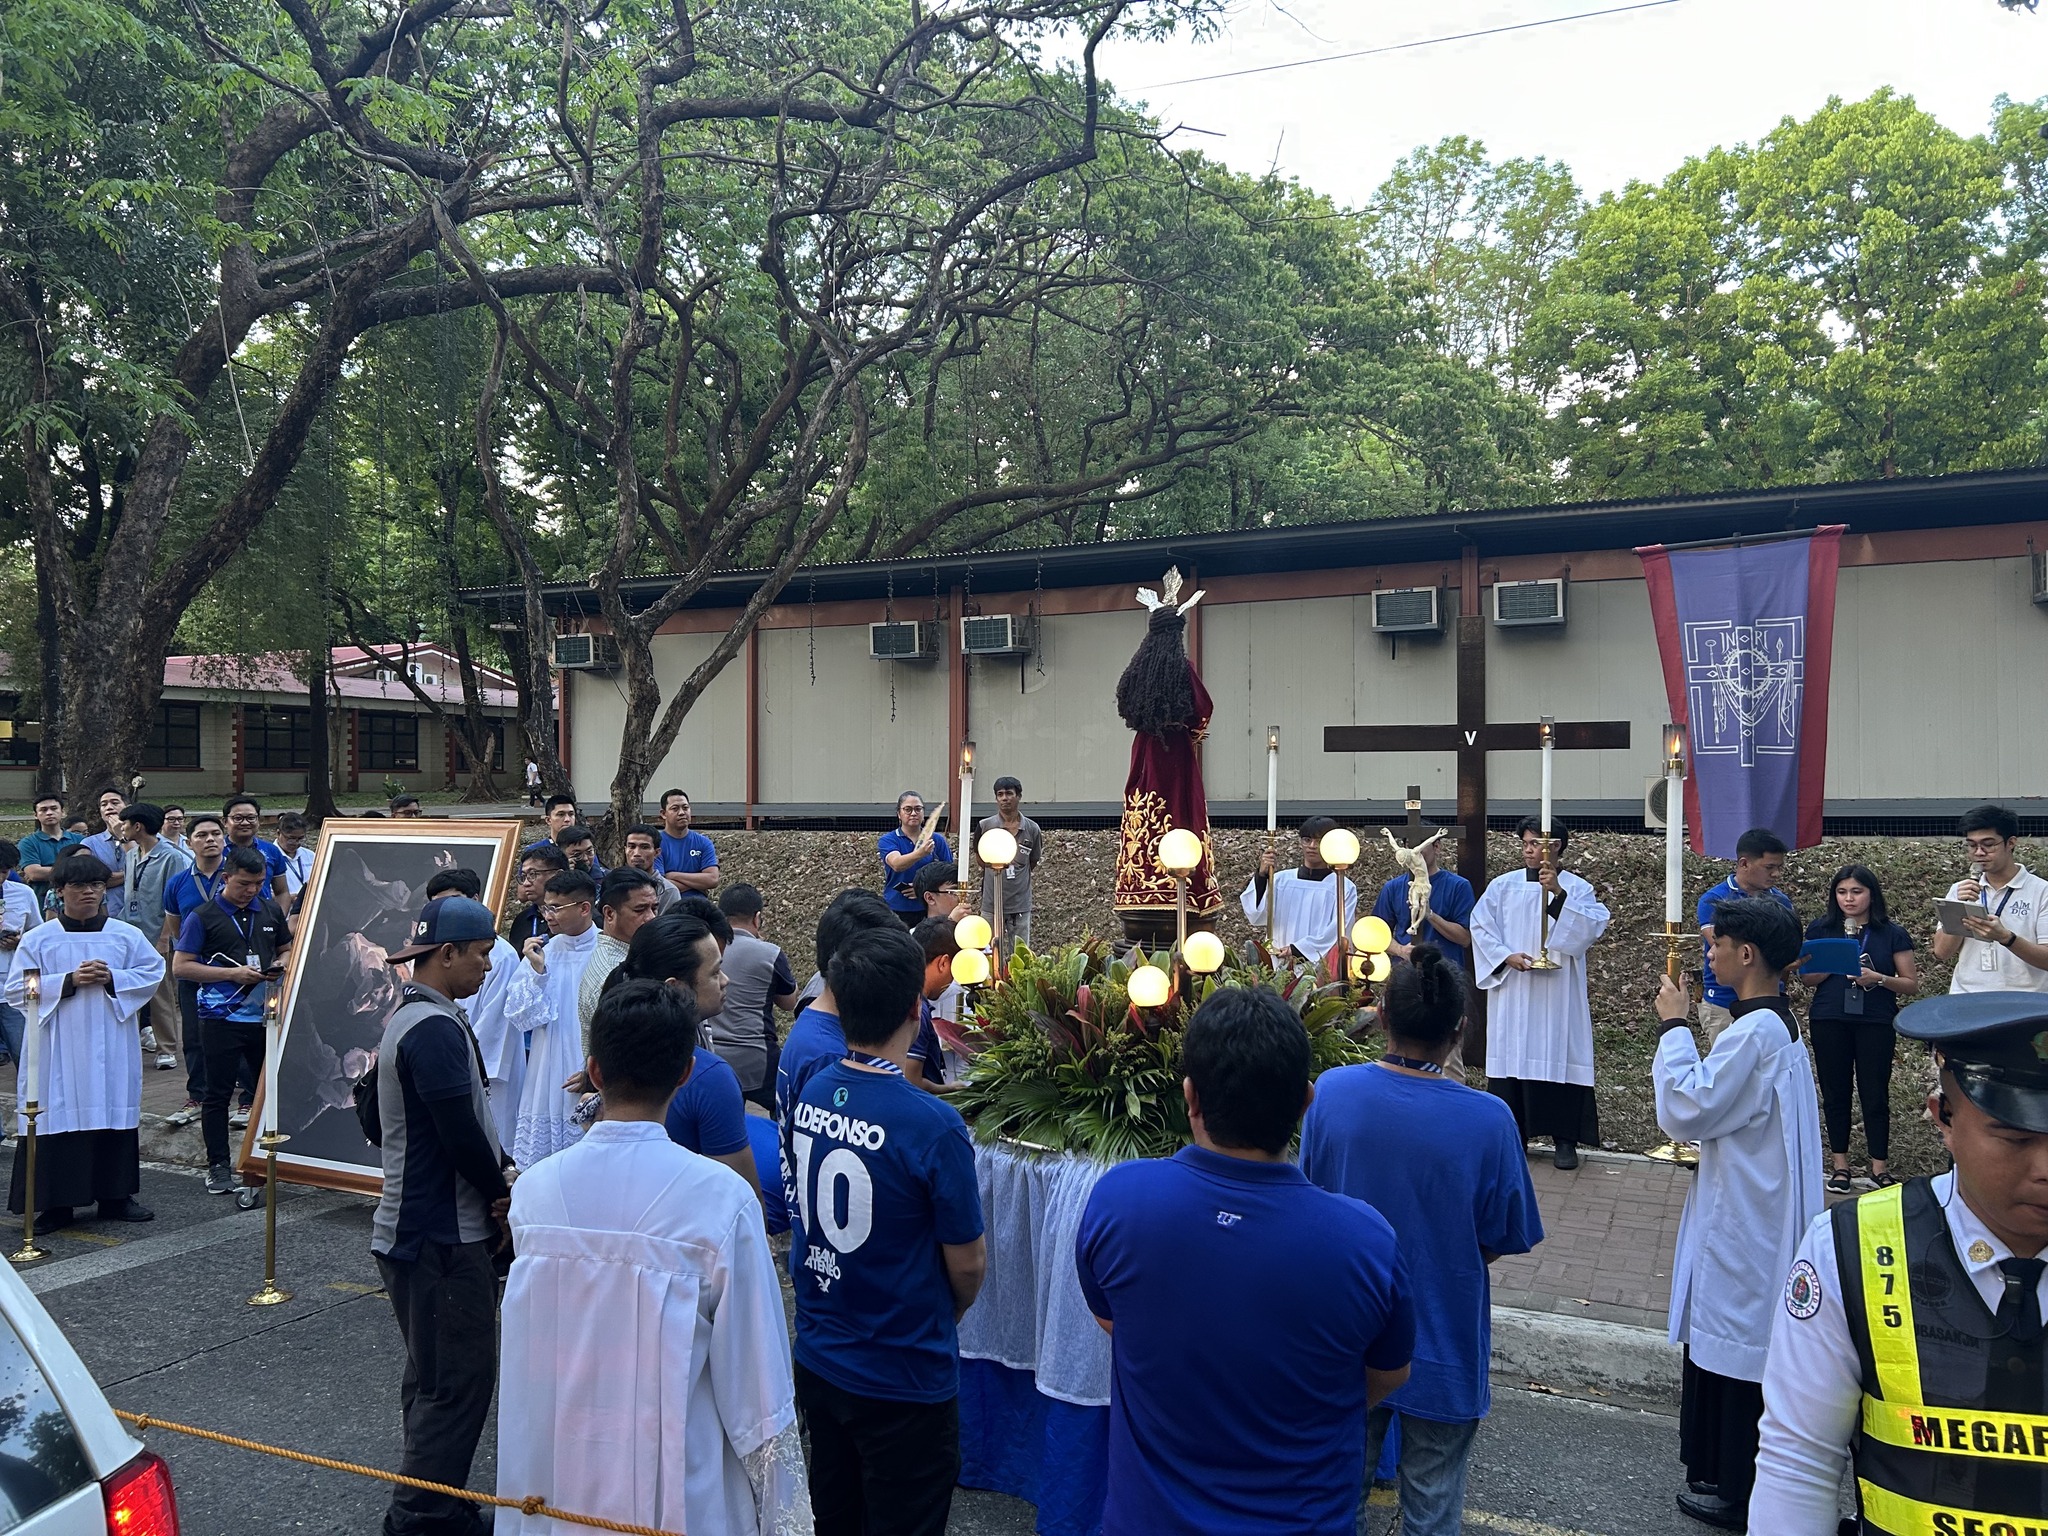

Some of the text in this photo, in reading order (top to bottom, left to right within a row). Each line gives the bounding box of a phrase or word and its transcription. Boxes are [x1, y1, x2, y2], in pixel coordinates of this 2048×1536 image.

[1464, 730, 1477, 746] V
[793, 1131, 873, 1254] 10
[808, 1244, 836, 1266] TEAM
[804, 1255, 841, 1280] ATENEO
[1932, 1512, 2048, 1536] SE
